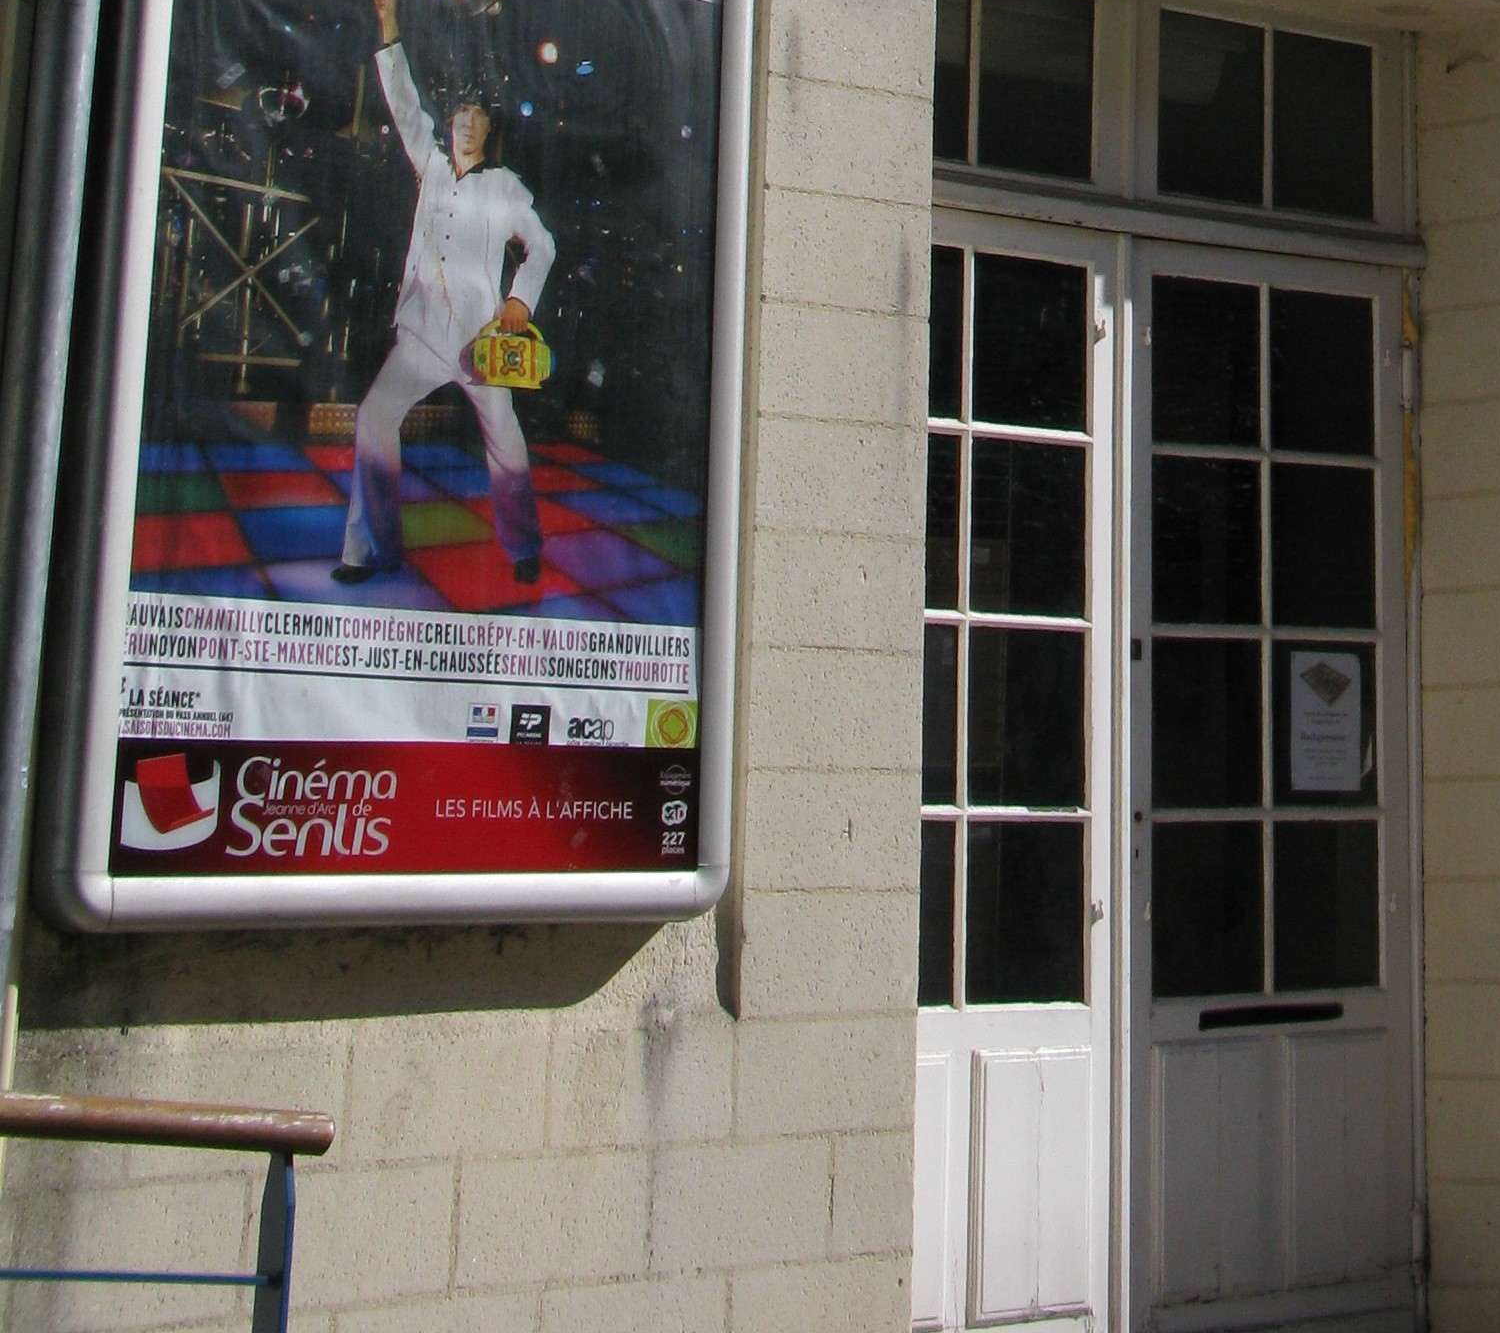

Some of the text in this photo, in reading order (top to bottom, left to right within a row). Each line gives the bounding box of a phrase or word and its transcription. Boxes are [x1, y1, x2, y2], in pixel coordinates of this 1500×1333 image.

[129, 688, 145, 707] LA
[566, 716, 616, 744] acap
[236, 755, 398, 801] Cinéma
[262, 800, 337, 816] Jeanne d'Arc
[351, 797, 373, 817] de
[435, 796, 634, 820] LES FILMS À L'AFFICHE
[224, 798, 392, 858] Senlis
[662, 831, 686, 845] 227
